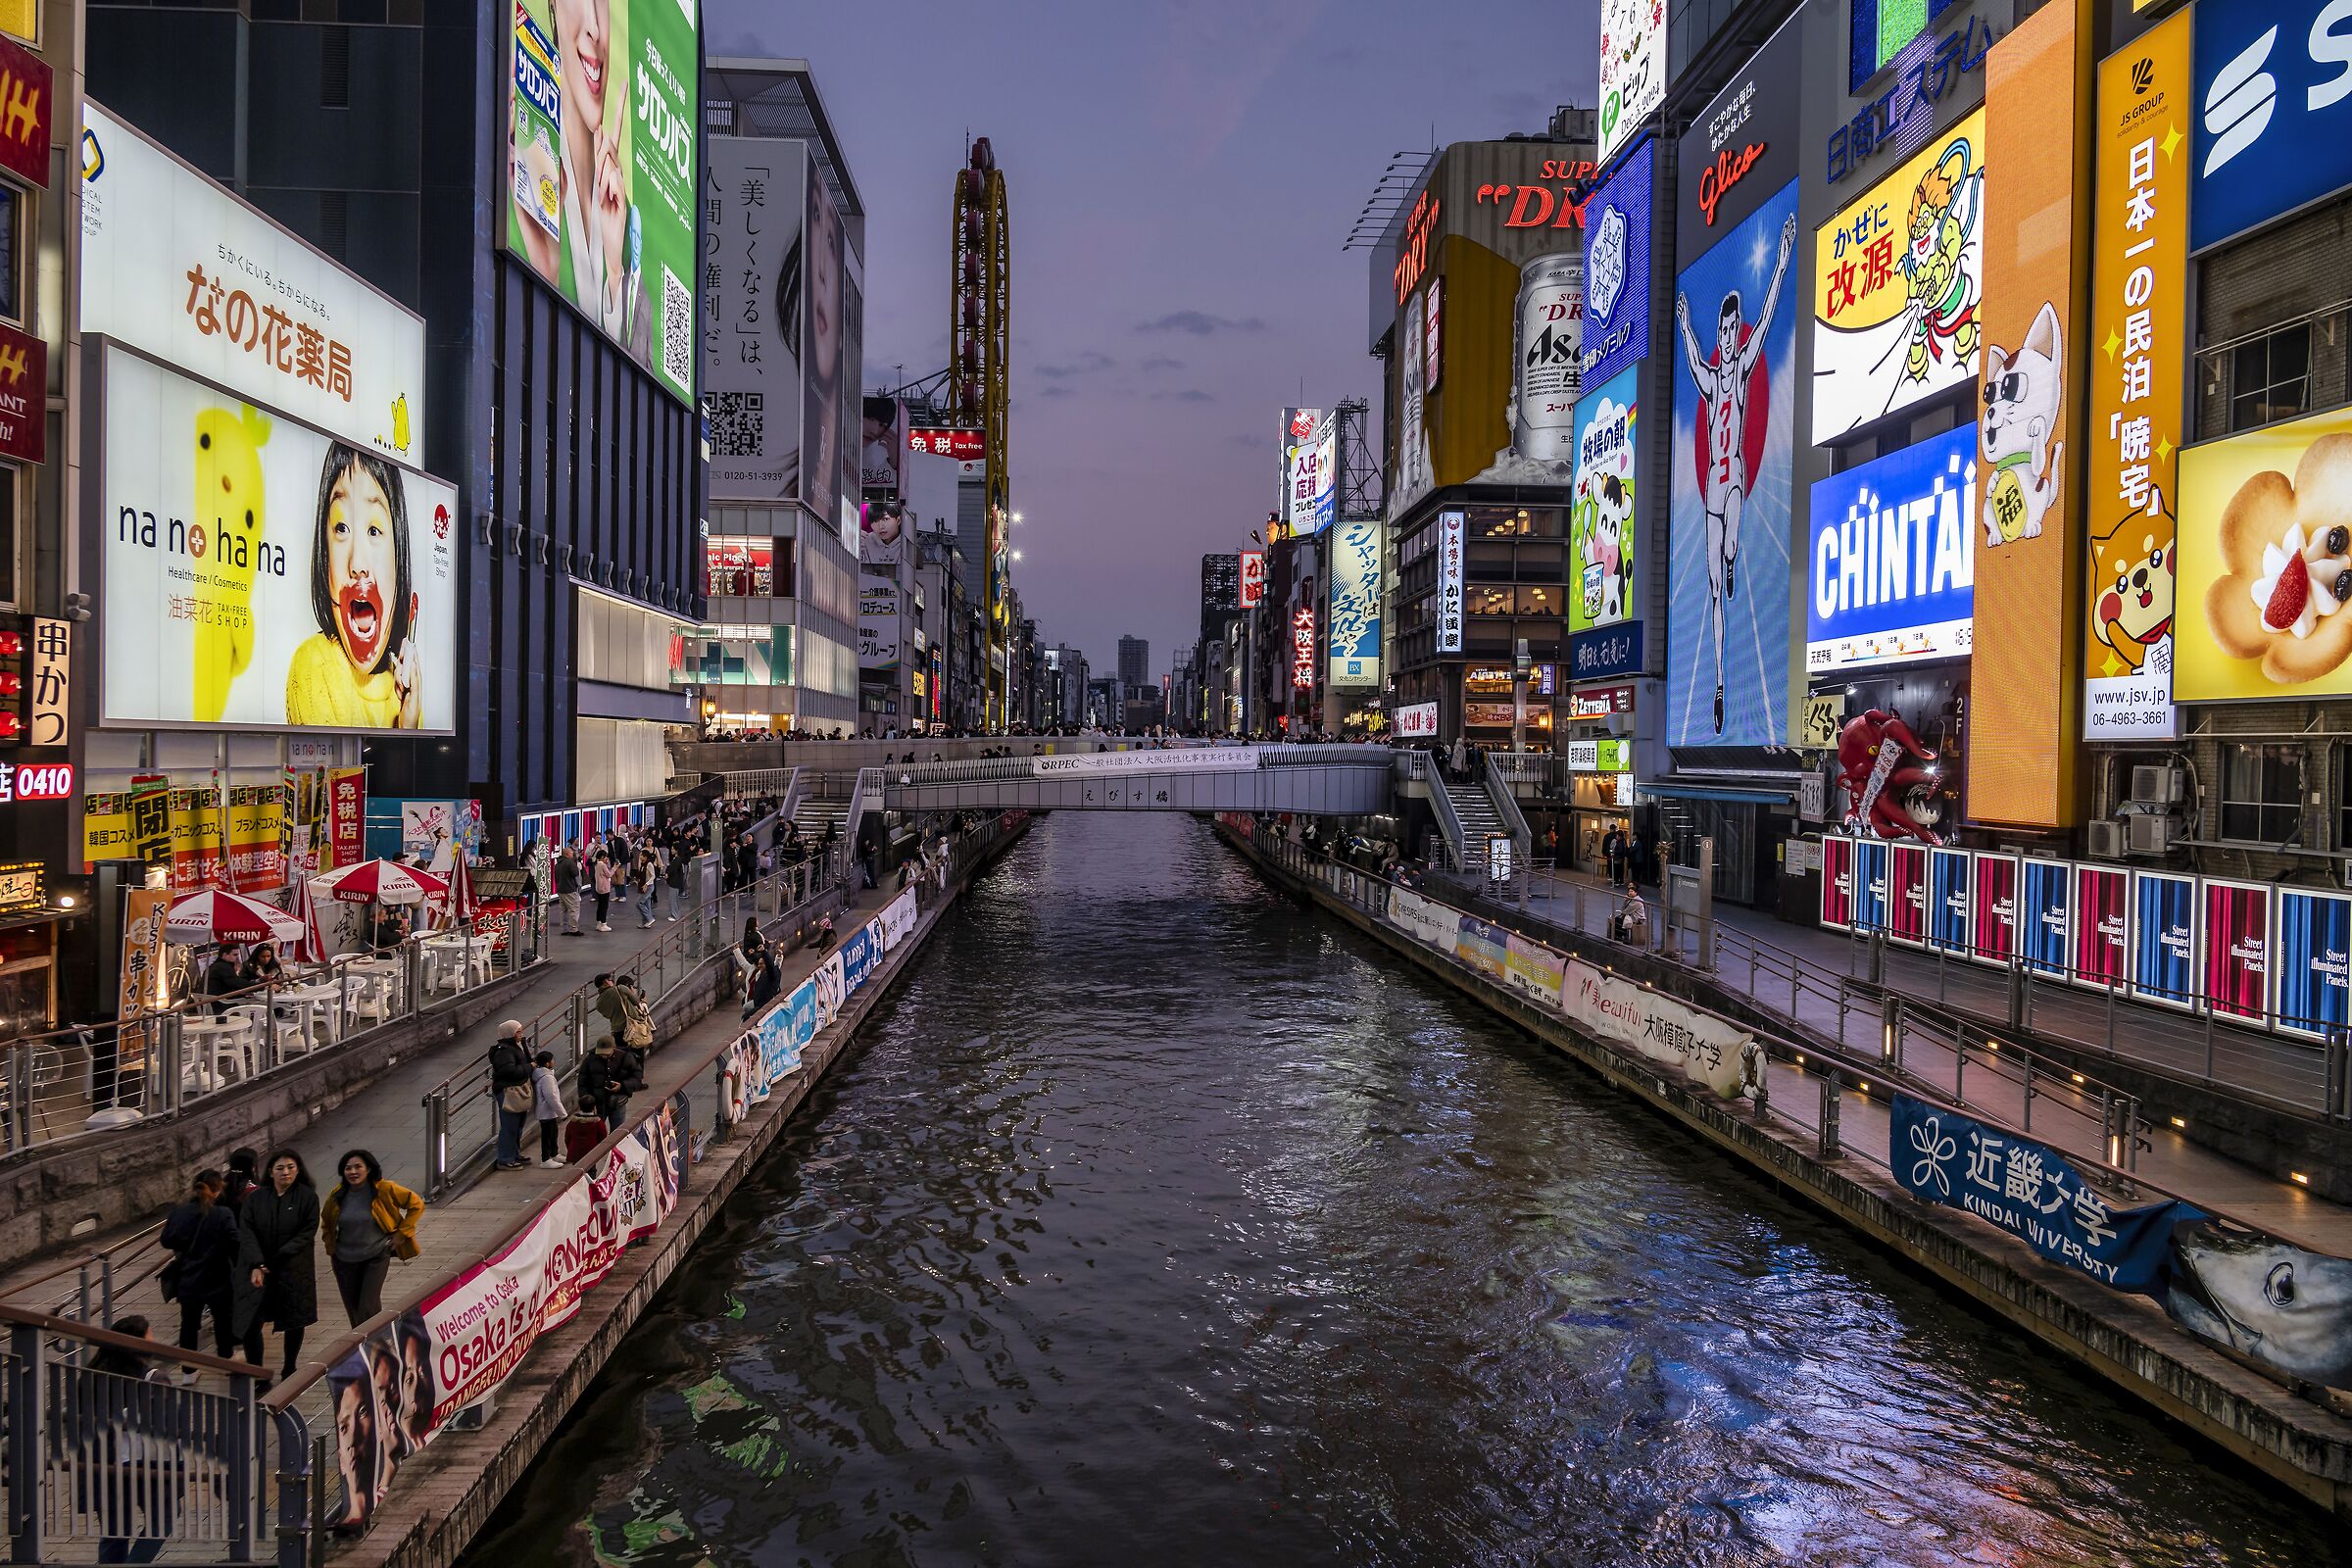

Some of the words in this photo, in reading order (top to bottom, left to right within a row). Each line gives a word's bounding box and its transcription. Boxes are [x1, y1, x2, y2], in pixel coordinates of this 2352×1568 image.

[517, 47, 560, 127] サロンパス
[1623, 51, 1651, 110] ピップ
[1642, 81, 1660, 109] 2024
[1828, 15, 1992, 185] 日商エステム
[2120, 112, 2131, 126] JS
[2132, 92, 2165, 119] GROUP
[637, 60, 693, 193] サロンパス
[1711, 103, 1752, 152] ゆたかな人生
[1540, 160, 1598, 179] SUP
[1698, 142, 1764, 227] Glico
[1833, 202, 1889, 260] かぜに
[218, 242, 331, 321] ちかくにいる。ちからになる。
[736, 167, 770, 376] 「美しくなる」は、
[1827, 228, 1894, 319] 改源
[186, 262, 353, 403] なの花薬局
[1545, 402, 1573, 413] スーパ
[1583, 415, 1626, 467] 牧場の朝
[1719, 393, 1733, 485] グリコ
[724, 470, 783, 481] 0120-51-3939
[1996, 483, 2025, 527] 福
[1446, 533, 1459, 579] 本場の味
[168, 565, 208, 584] Healthcare
[214, 575, 248, 592] Cosmetics
[168, 592, 213, 624] 油菜花
[1445, 583, 1460, 648] かに道楽
[1293, 608, 1314, 688] 大阪王将
[35, 621, 69, 744] 串かつ
[2094, 686, 2166, 707] www.jsv.jp
[1578, 697, 1611, 715] ZETTERIA
[1809, 702, 1837, 742] くくる
[2092, 710, 2167, 726] 06-4963-3661
[18, 767, 72, 797] 0410
[1085, 789, 1168, 803] えびす橋
[172, 821, 221, 839] ガニックコス
[336, 781, 360, 841] 免税店
[88, 828, 136, 848] 韓国コスメ
[339, 891, 369, 902] KIRIN
[381, 882, 416, 891] KIRIN
[427, 890, 447, 900] KIRIN
[166, 917, 209, 926] KIRIN
[222, 931, 261, 941] KIRIN
[268, 916, 296, 925] KIRIN
[2108, 913, 2123, 926] Street
[2172, 924, 2188, 937] Street
[2244, 936, 2263, 950] Street
[2326, 949, 2347, 963] Street
[124, 950, 149, 1018] 串カツ
[1965, 1132, 2117, 1248] 近畿大学
[1963, 1192, 2021, 1230] KINDAI
[435, 1299, 487, 1344] Welcome
[484, 1293, 499, 1309] to
[495, 1275, 519, 1300] Osaka
[439, 1316, 506, 1392] Osaka
[509, 1296, 525, 1338] is
